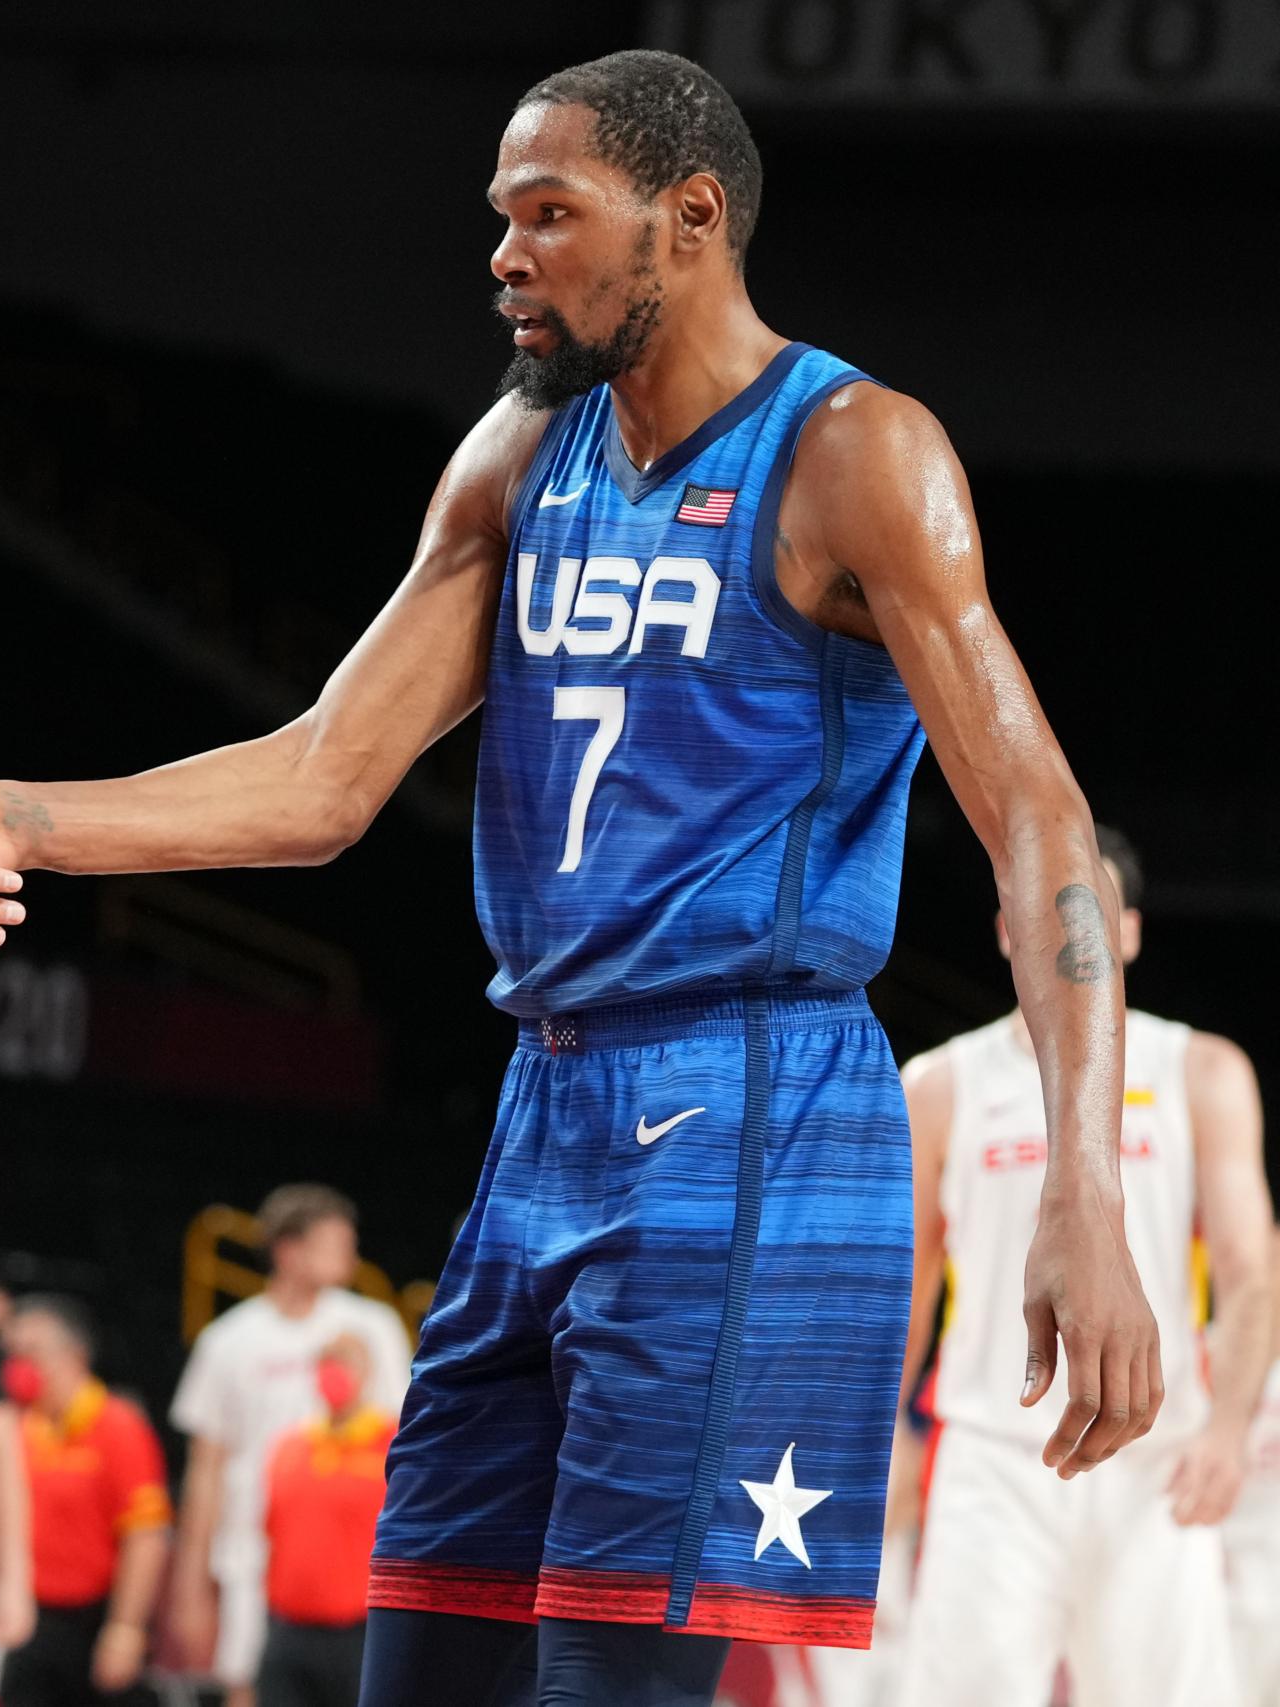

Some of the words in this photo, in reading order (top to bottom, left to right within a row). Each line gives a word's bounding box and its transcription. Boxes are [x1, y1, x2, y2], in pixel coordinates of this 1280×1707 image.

[518, 553, 721, 659] USA
[553, 686, 626, 873] 7
[982, 1139, 1152, 1170] ESA
